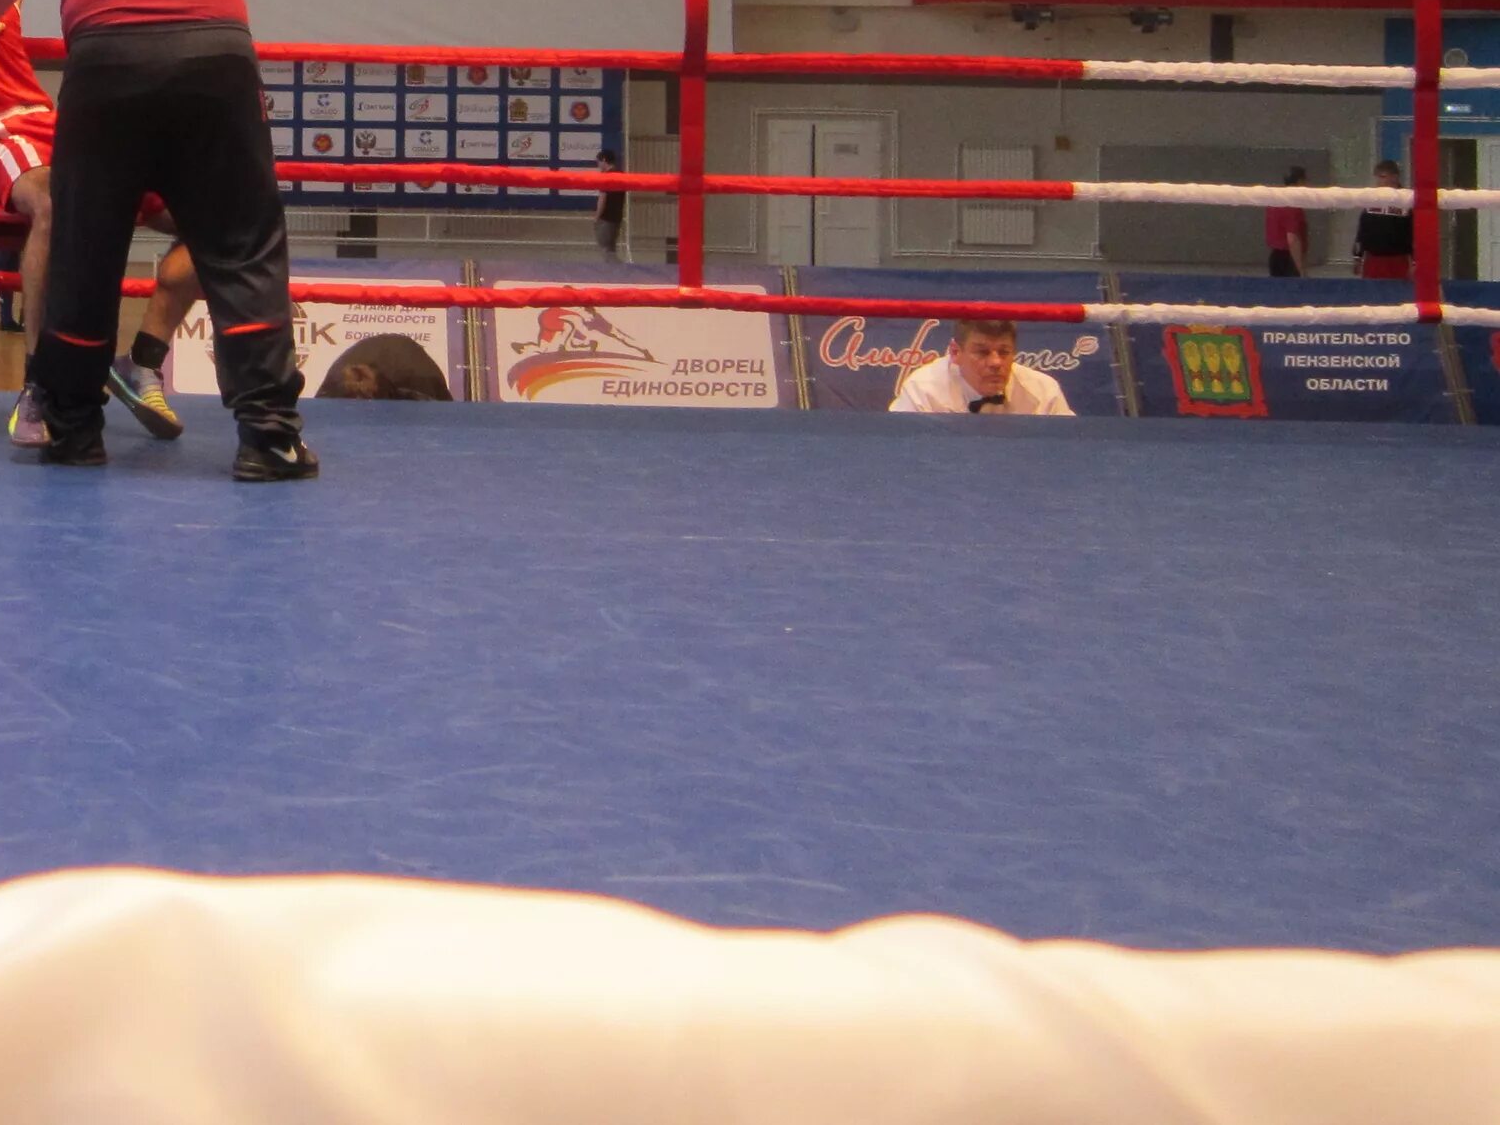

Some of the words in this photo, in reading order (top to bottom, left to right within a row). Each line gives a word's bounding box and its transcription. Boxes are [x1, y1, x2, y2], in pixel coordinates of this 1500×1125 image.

[342, 314, 436, 324] ЕДИНОБОРСТВ
[1263, 332, 1411, 345] ПРАВИТЕЛЬСТВО
[671, 358, 765, 376] ДВОРЕЦ
[1284, 354, 1401, 368] ПЕНЗЕНСКОЙ
[601, 379, 768, 398] ЕДИНОБОРСТВ
[1306, 378, 1389, 392] ОБЛАСТИ
